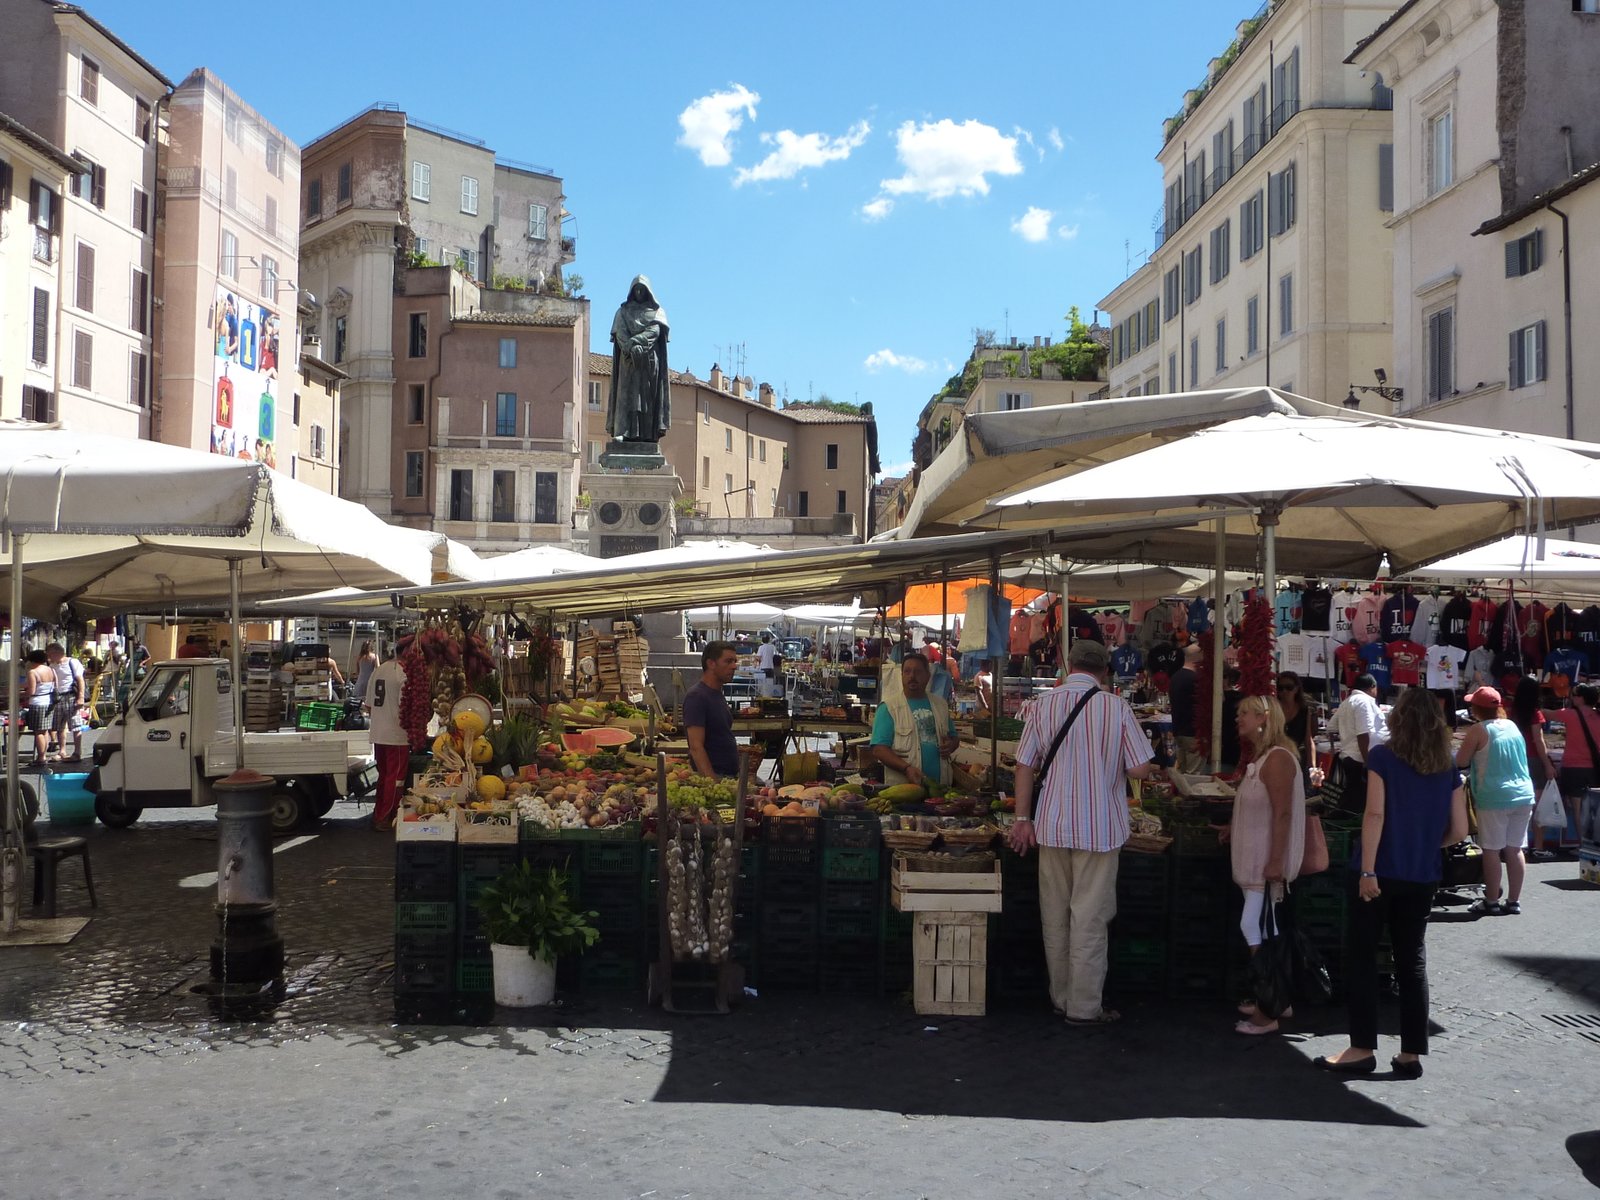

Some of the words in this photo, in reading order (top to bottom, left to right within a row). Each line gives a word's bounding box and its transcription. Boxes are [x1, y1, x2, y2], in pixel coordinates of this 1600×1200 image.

[244, 329, 252, 366] 1
[1280, 606, 1289, 621] I
[1335, 607, 1344, 623] I
[1366, 611, 1374, 626] I
[1391, 609, 1401, 626] I
[374, 679, 385, 707] 9
